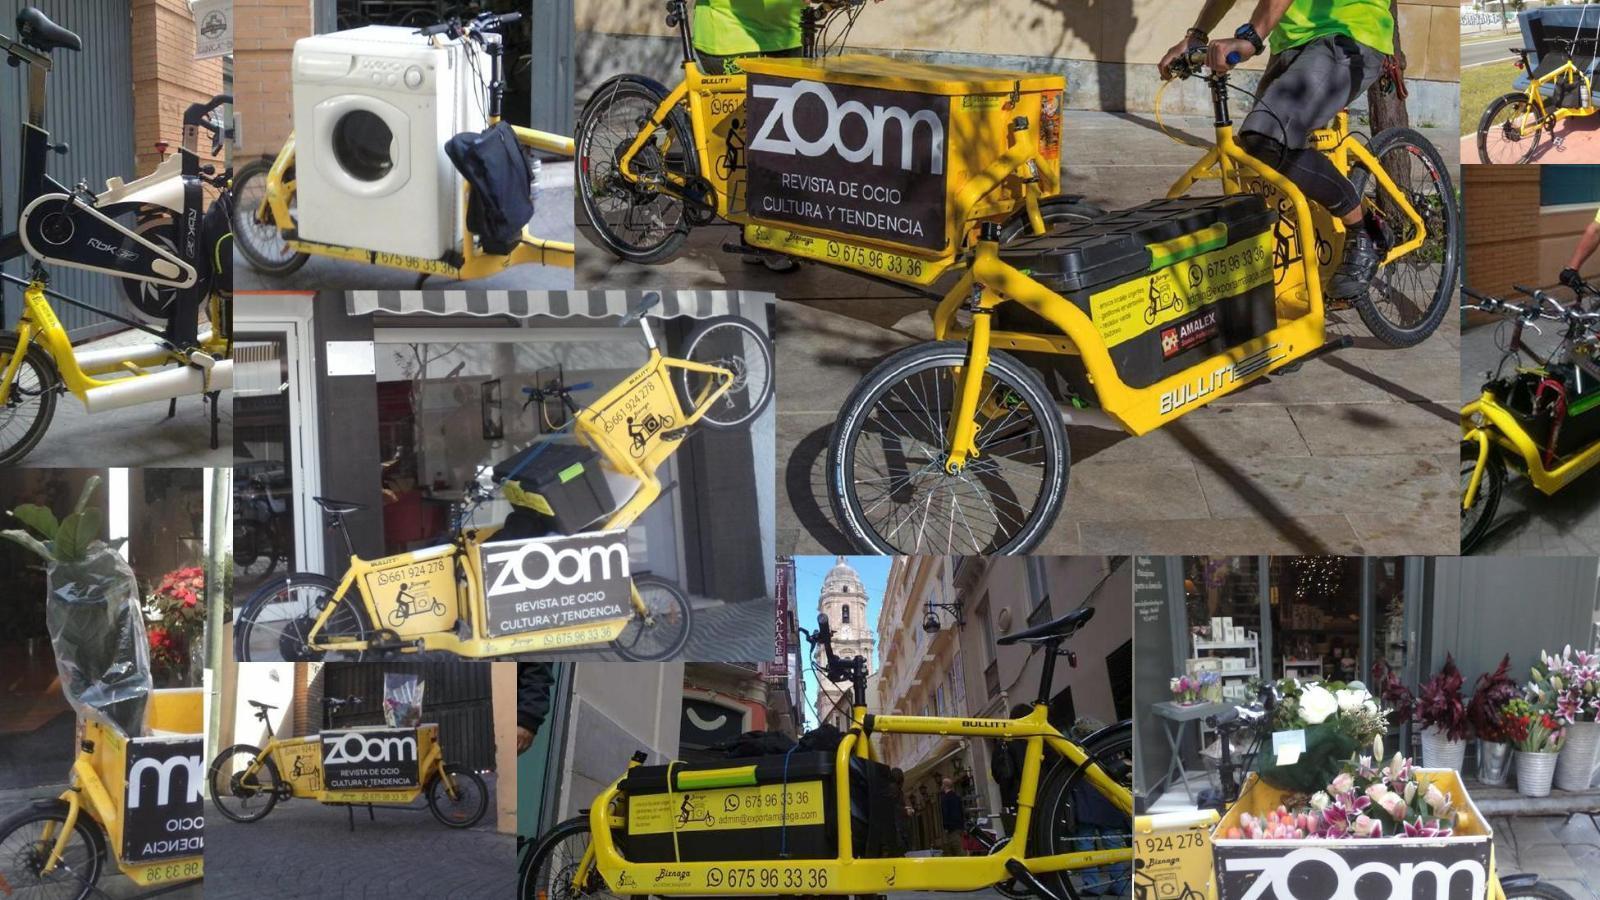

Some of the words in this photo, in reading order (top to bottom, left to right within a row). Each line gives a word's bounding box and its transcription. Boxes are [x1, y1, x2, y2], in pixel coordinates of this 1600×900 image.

[782, 173, 836, 195] REVISTA
[839, 181, 859, 199] DE
[862, 184, 902, 205] OCIO
[762, 196, 823, 220] CULTURA
[826, 205, 836, 221] Y
[838, 207, 924, 238] TENDENCIA
[381, 250, 403, 266] 675
[404, 255, 420, 269] 96
[422, 258, 438, 273] 33
[843, 244, 865, 266] 675
[868, 250, 884, 270] 96
[887, 254, 903, 274] 33
[906, 258, 923, 278] 36
[1207, 258, 1228, 278] 675
[1228, 254, 1241, 272] 96
[1241, 249, 1253, 266] 33
[1253, 244, 1265, 262] 36
[1180, 312, 1217, 338] AMALEX
[1160, 363, 1238, 415] BULLITT
[612, 408, 627, 426] 661
[625, 395, 640, 411] 924
[642, 381, 656, 398] 278
[389, 569, 407, 583] 661
[409, 566, 426, 579] 924
[428, 560, 445, 574] 278
[515, 598, 560, 613] REVISTA
[561, 595, 575, 607] DE
[578, 591, 606, 604] OCIO
[500, 615, 550, 631] CULTURA
[551, 614, 559, 625] Y
[561, 605, 622, 622] TENDENCIA
[556, 633, 573, 645] 675
[574, 630, 586, 642] 96
[587, 628, 599, 640] 33
[600, 626, 612, 638] 36
[775, 609, 784, 656] PALACE
[961, 720, 1008, 728] BULLITT
[331, 779, 362, 787] CULTURA
[370, 777, 411, 786] TENDENCIA
[340, 769, 368, 777] REVISTA
[369, 768, 379, 776] DE
[745, 795, 762, 809] 675
[764, 793, 778, 807] 96
[796, 791, 809, 805] 36
[1145, 836, 1173, 853] 924
[1176, 832, 1204, 849] 278
[728, 868, 755, 888] 675
[760, 868, 779, 888] 96
[784, 868, 803, 888] 33
[808, 868, 828, 889] 36
